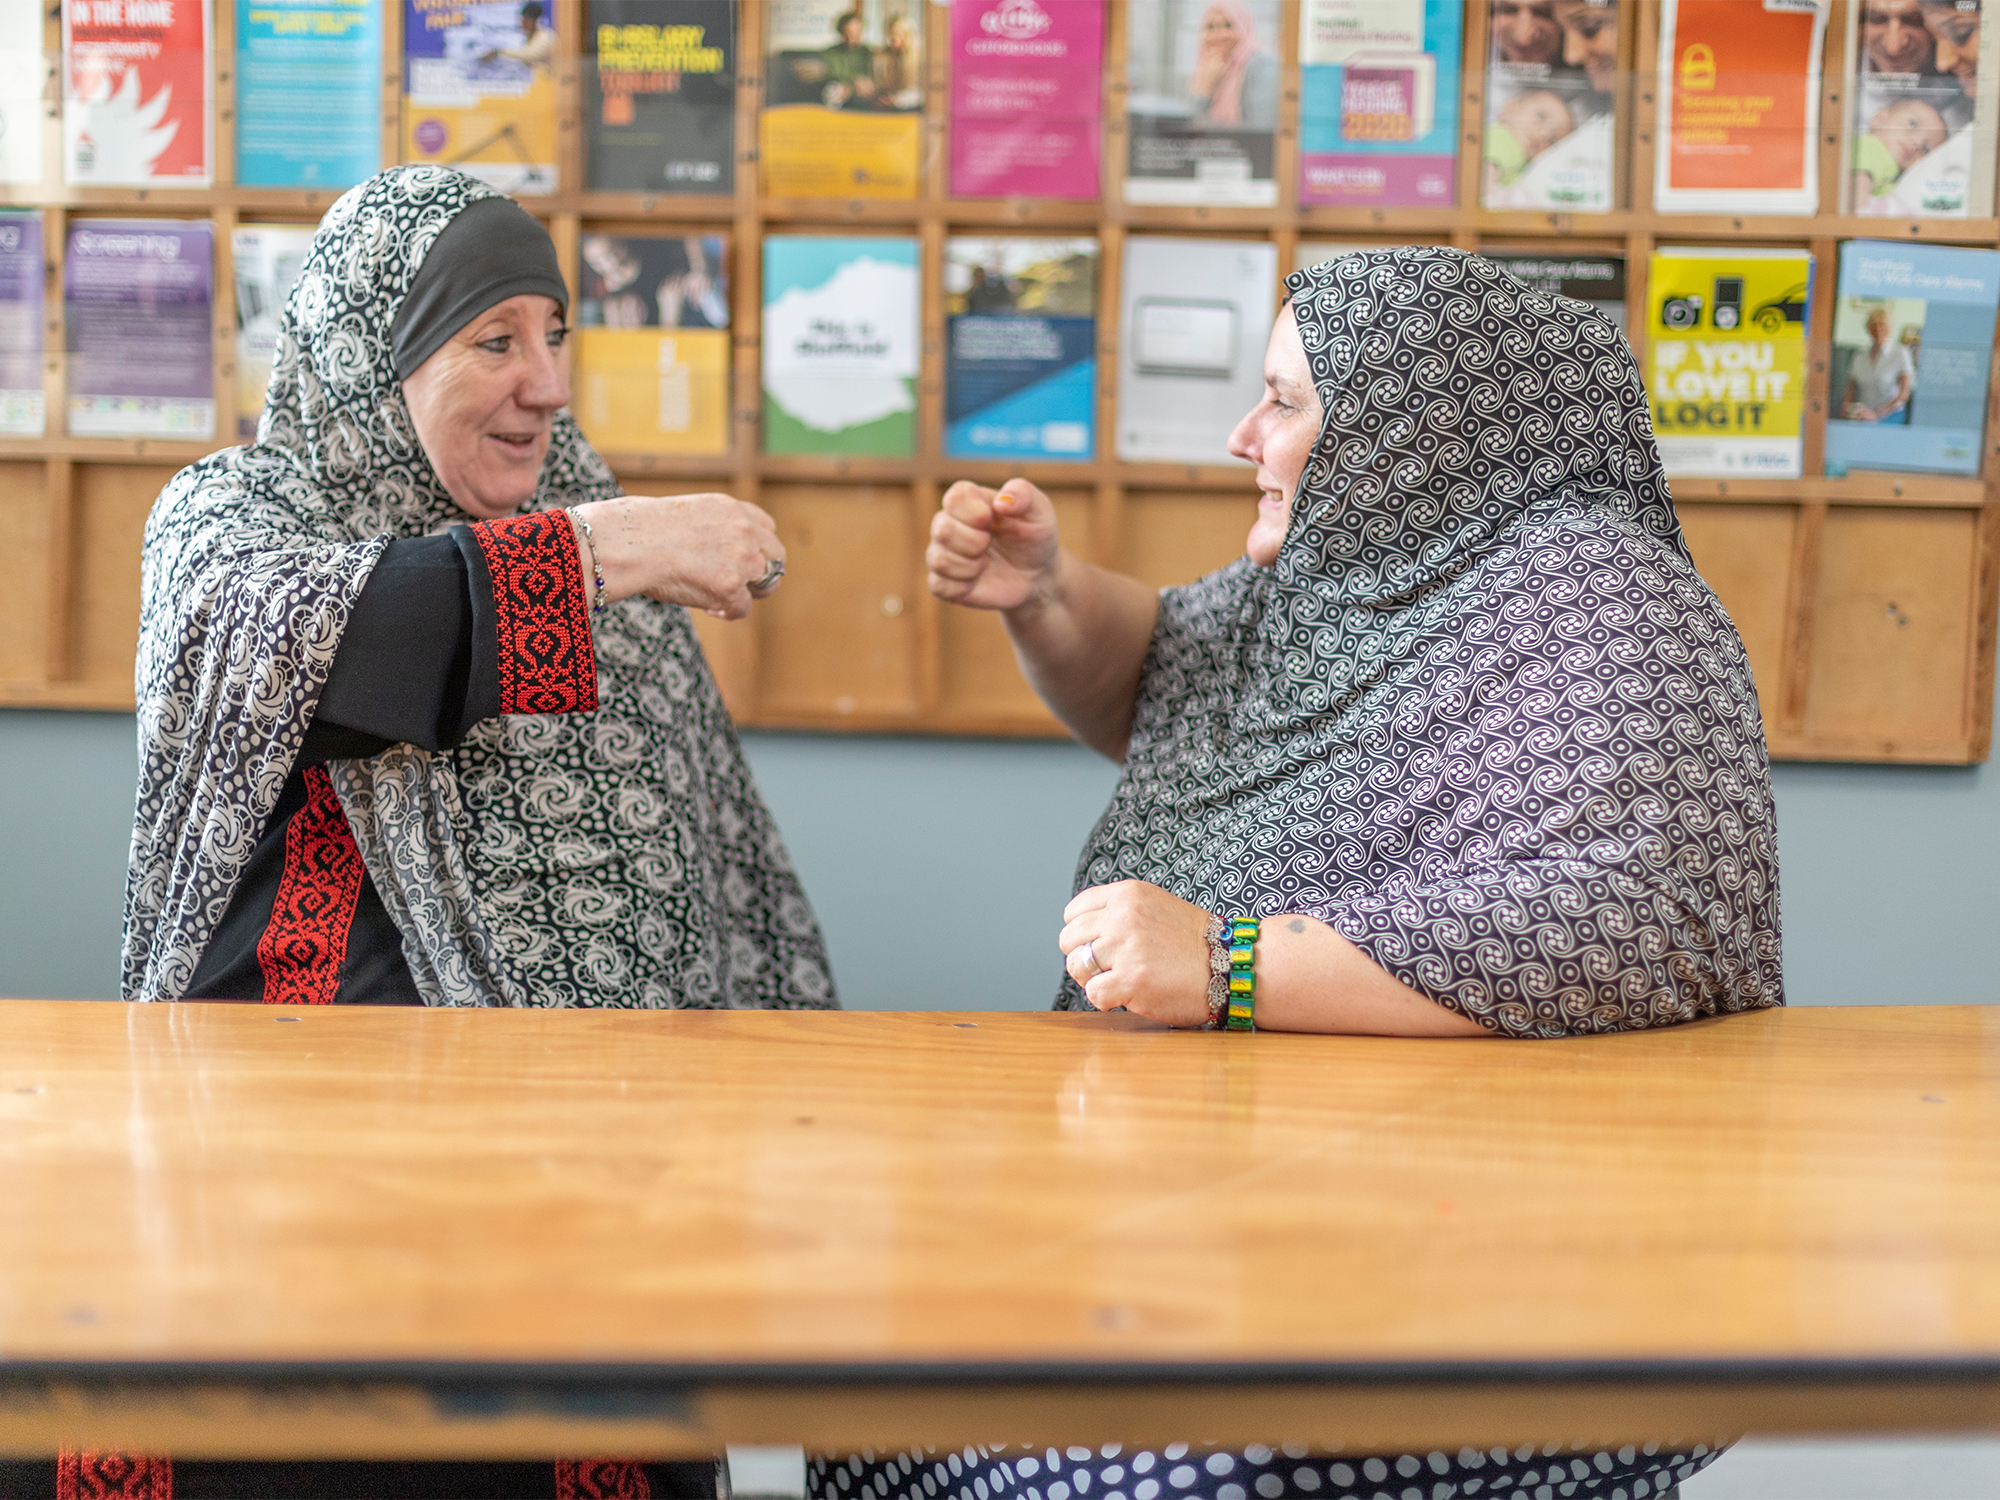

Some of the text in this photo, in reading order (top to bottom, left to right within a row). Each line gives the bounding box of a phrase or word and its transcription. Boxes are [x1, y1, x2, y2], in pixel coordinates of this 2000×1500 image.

[93, 0, 122, 26] THE
[125, 0, 175, 28] HOME
[75, 230, 181, 263] Screening
[1656, 341, 1775, 371] IF YOU
[1655, 370, 1789, 402] LOVE IT
[1656, 402, 1768, 430] LOG IT
